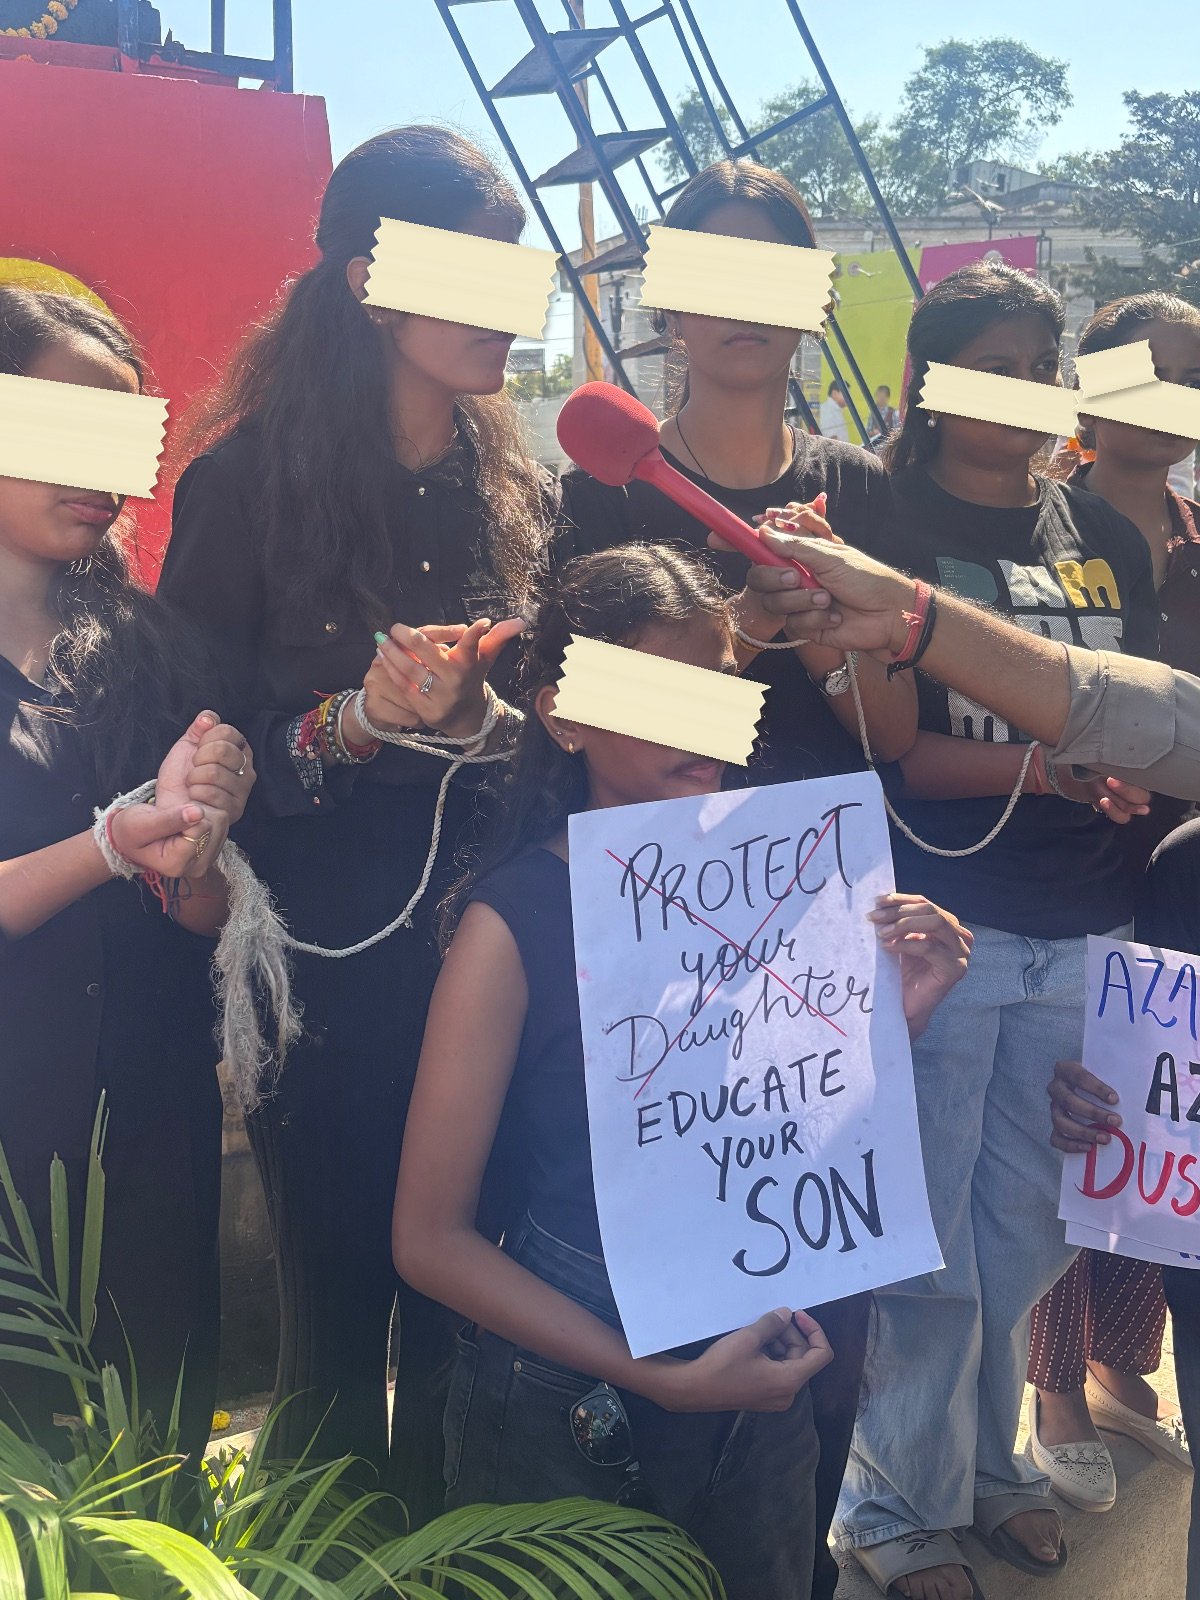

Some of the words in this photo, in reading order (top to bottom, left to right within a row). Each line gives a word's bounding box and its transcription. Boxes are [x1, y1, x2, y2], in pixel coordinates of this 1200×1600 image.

[620, 803, 862, 941] PROTECT
[603, 965, 874, 1082] Daughter
[681, 928, 796, 1013] your
[636, 1048, 845, 1148] EDUCATE
[701, 1120, 804, 1202] YOUR
[731, 1148, 884, 1277] SON
